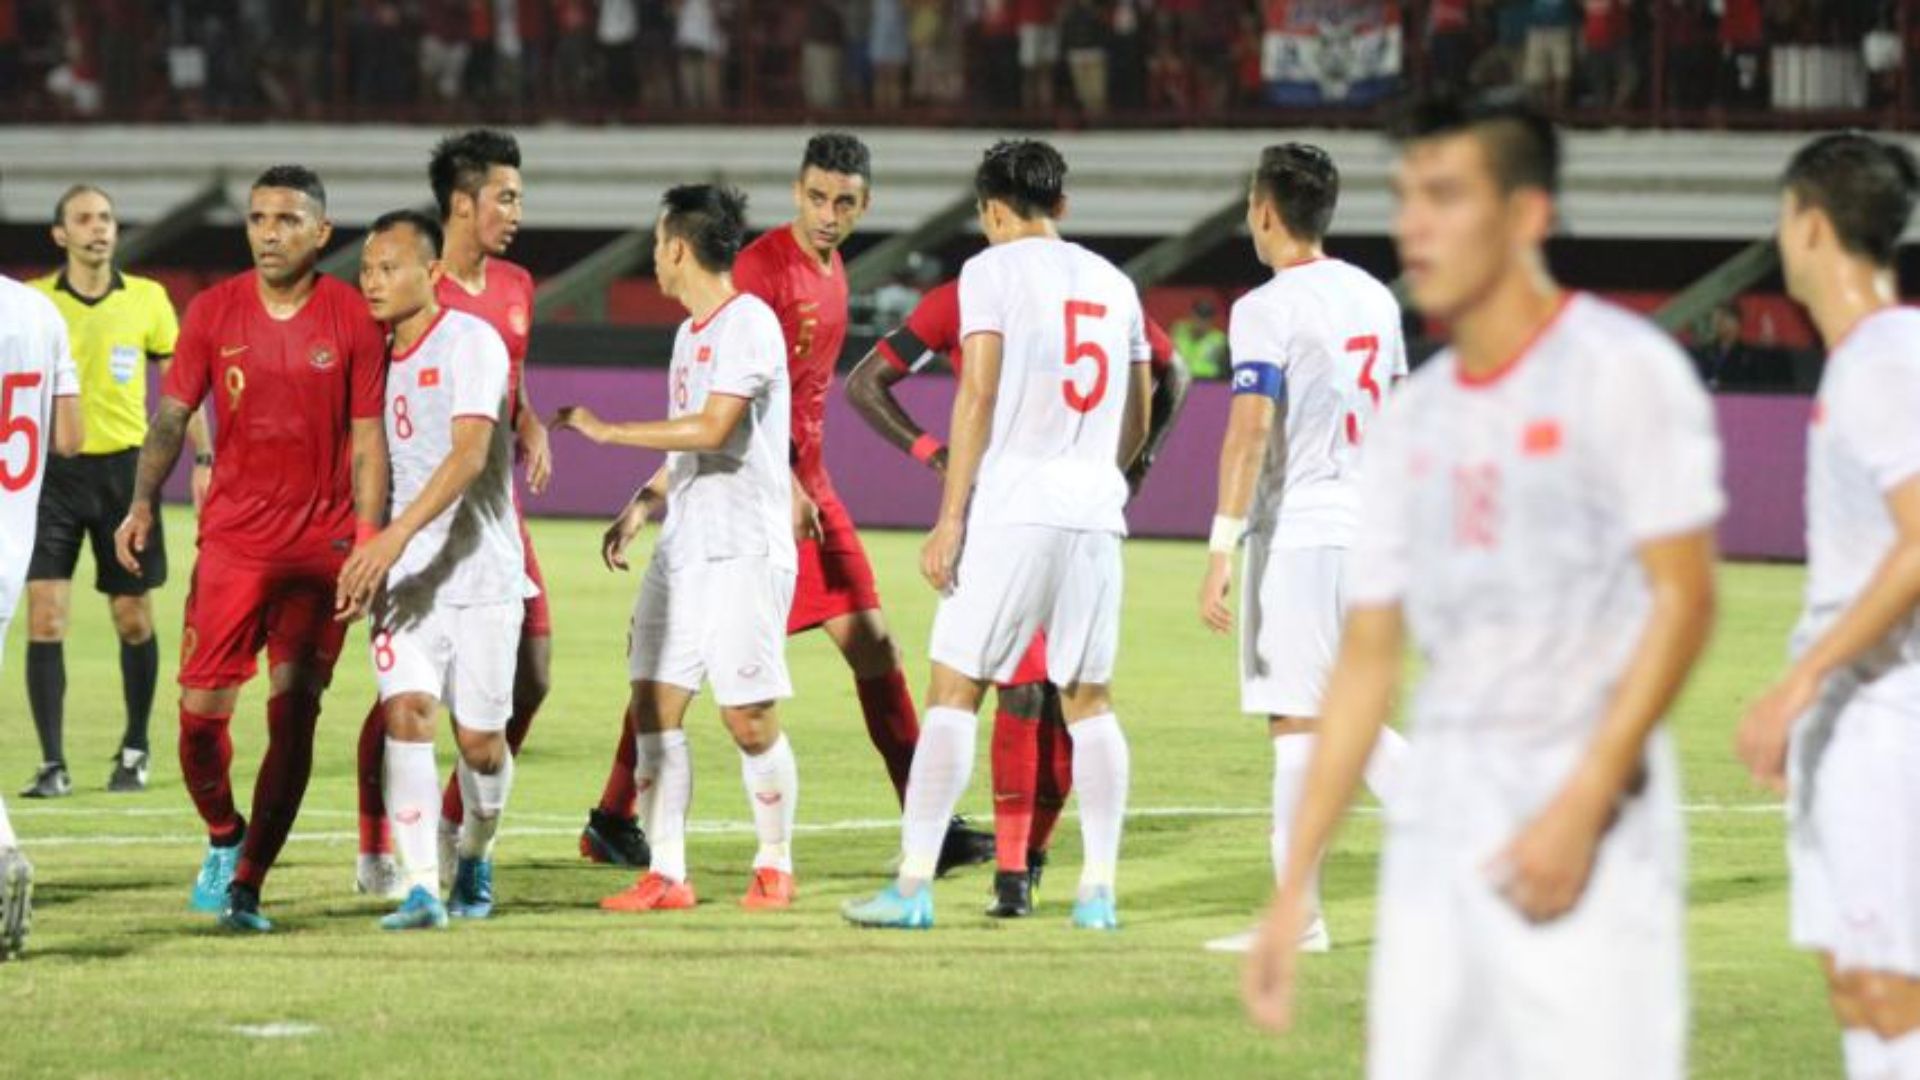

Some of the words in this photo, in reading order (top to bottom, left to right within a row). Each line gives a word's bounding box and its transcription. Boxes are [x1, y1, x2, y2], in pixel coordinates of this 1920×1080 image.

[1063, 300, 1108, 413] 5
[224, 365, 245, 411] 9
[0, 371, 41, 492] 5
[393, 394, 413, 440] 8
[371, 628, 395, 672] 8
